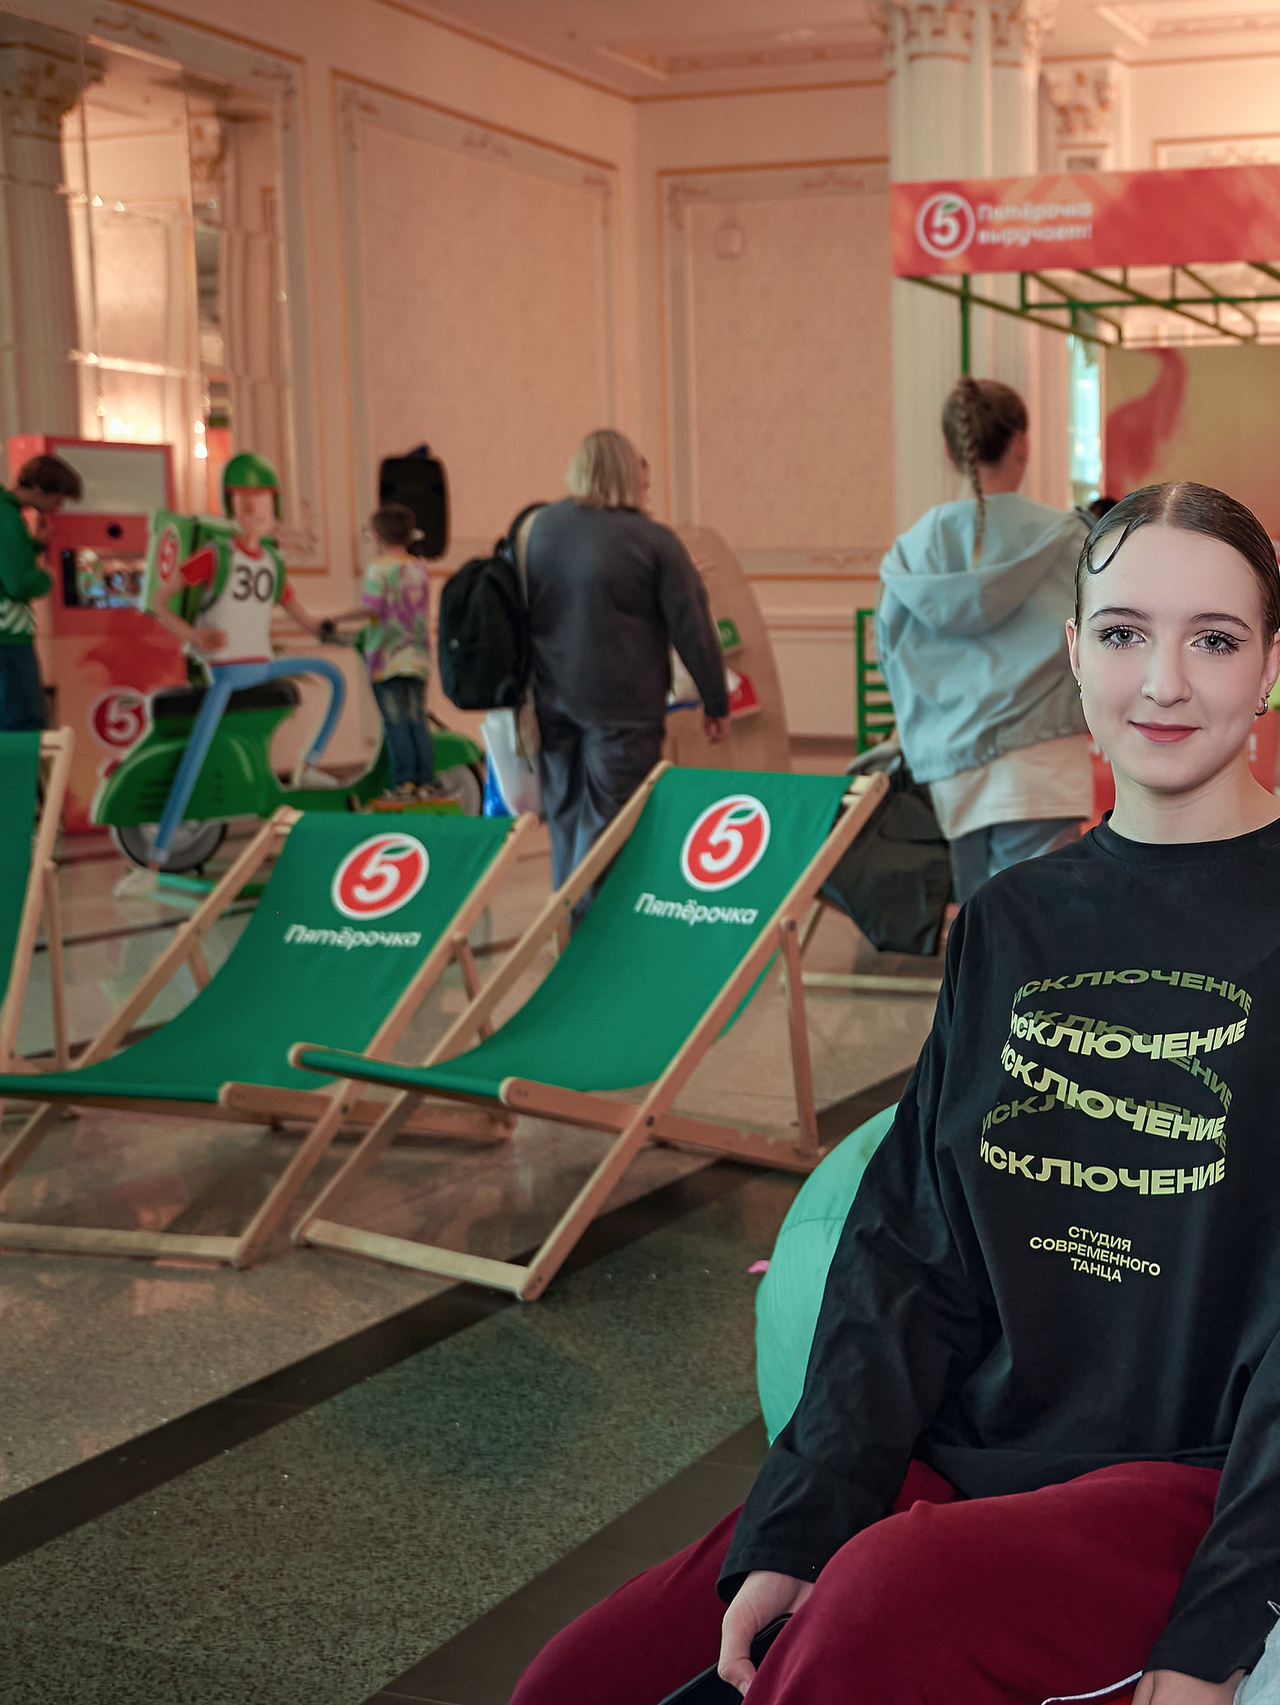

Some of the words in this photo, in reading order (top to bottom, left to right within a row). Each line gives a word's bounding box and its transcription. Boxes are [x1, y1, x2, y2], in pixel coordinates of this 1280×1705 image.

[233, 566, 273, 601] 30
[634, 892, 758, 926] Пятёрочка
[284, 924, 421, 951] Пятёрочка
[1011, 969, 1252, 1017] ИСКЛЮЧЕНИЕ
[1011, 1009, 1247, 1060] ИСКЛЮЧЕНИЕ
[1001, 1042, 1227, 1141] ИСКЛЮЧЕНИЕ
[980, 1136, 1226, 1195] ИСКЛЮЧЕНИЕ
[1029, 1236, 1161, 1276] СОВРЕМЕННОГО
[1068, 1226, 1132, 1252] СТУДИЯ
[1070, 1257, 1122, 1283] ТАНЦА
